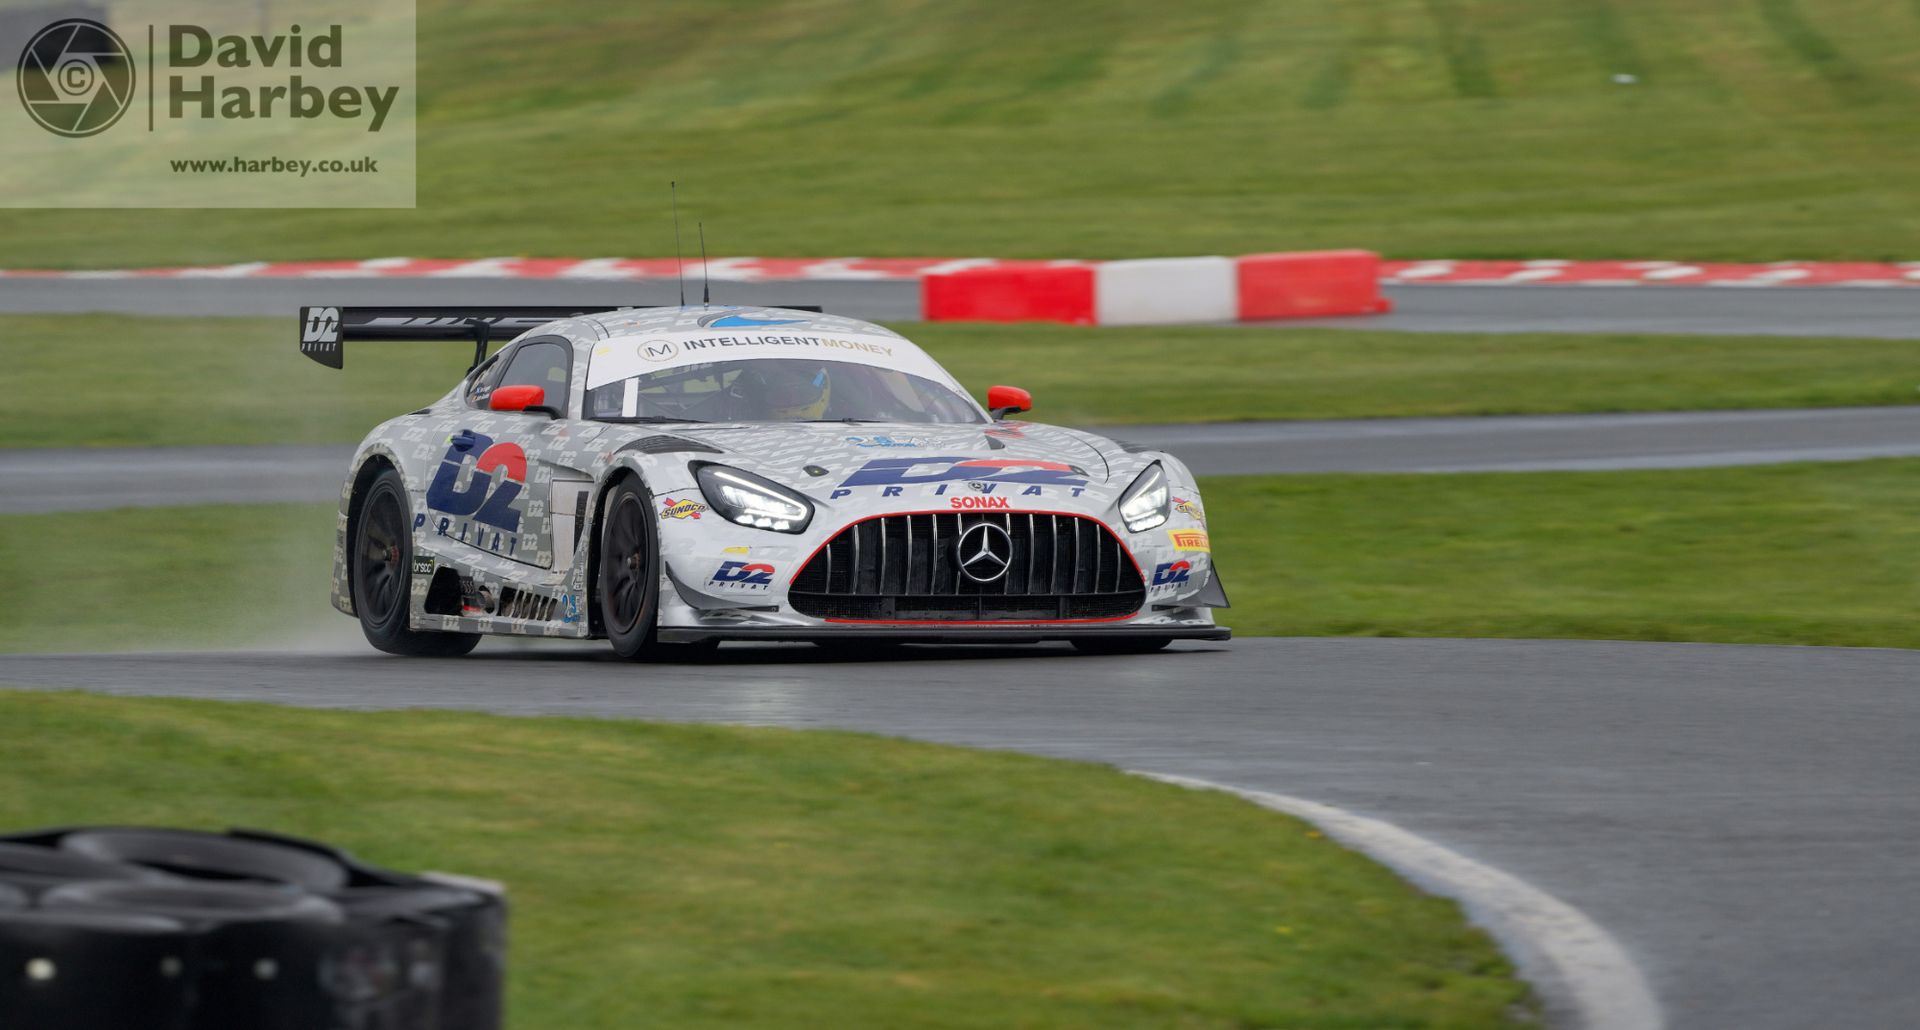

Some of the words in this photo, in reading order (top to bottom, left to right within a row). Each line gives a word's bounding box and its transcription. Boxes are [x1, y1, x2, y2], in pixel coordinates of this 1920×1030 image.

[303, 307, 339, 342] D2
[426, 429, 527, 533] D2
[837, 456, 1089, 488] D2
[830, 483, 1085, 500] PRIVAT
[950, 496, 1010, 509] SONAX
[663, 503, 706, 517] SUNOCO
[413, 513, 517, 556] PRIVAT
[413, 559, 432, 573] brscc
[712, 561, 775, 585] D2
[1152, 560, 1190, 586] D2
[708, 580, 768, 591] PRIVAT
